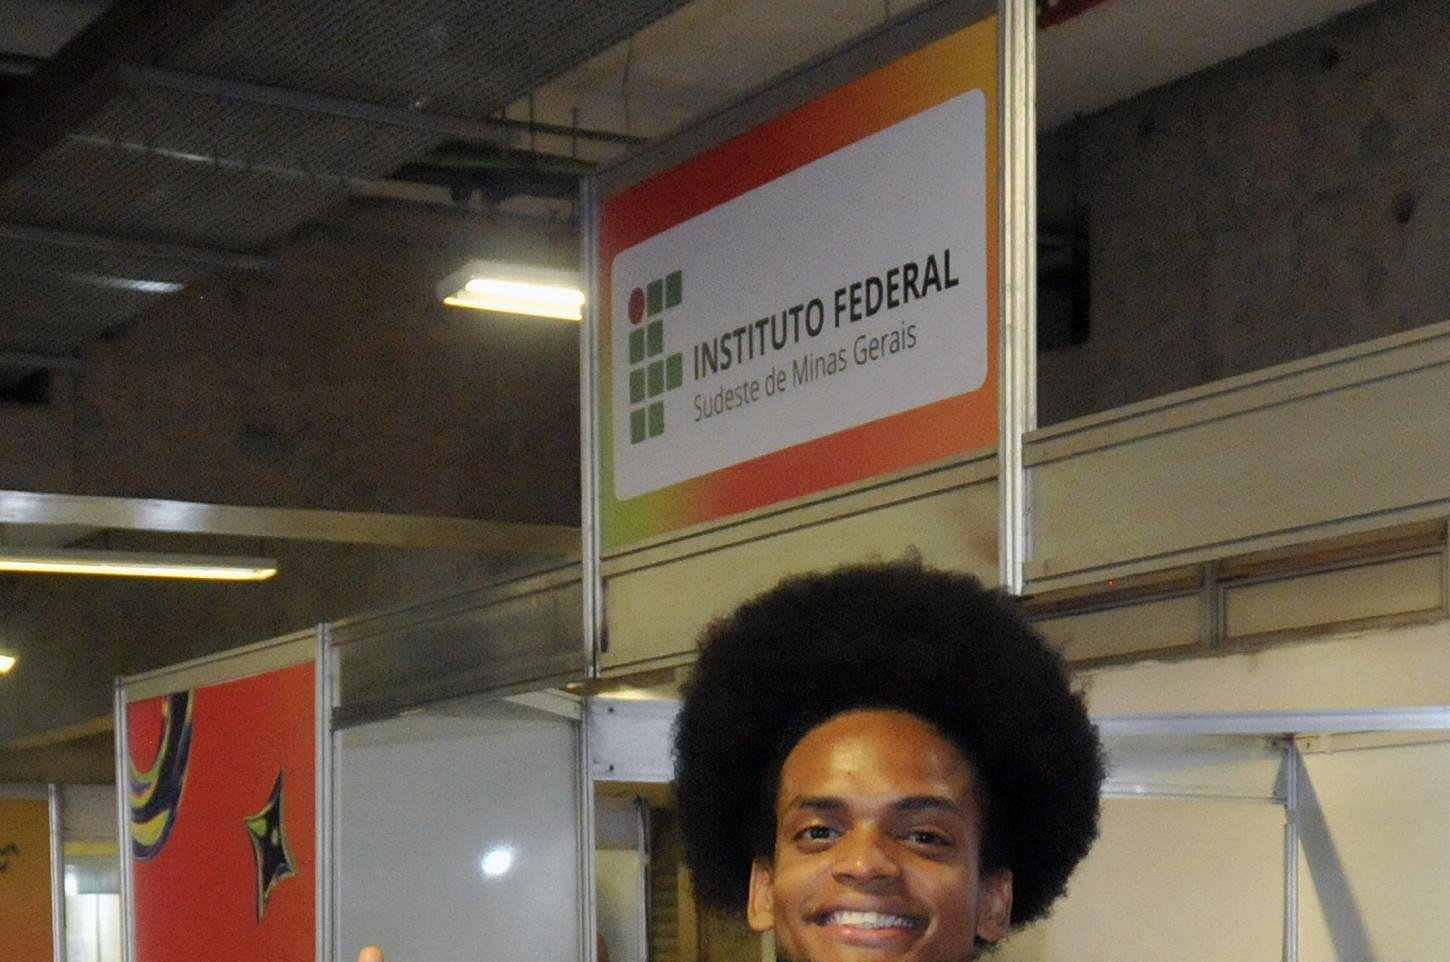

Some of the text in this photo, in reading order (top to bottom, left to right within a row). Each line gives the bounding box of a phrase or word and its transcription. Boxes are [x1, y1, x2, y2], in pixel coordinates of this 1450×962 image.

[694, 249, 959, 380] INSTITUTO FEDERAL
[694, 321, 917, 422] Sudeste de Minas Gerais
